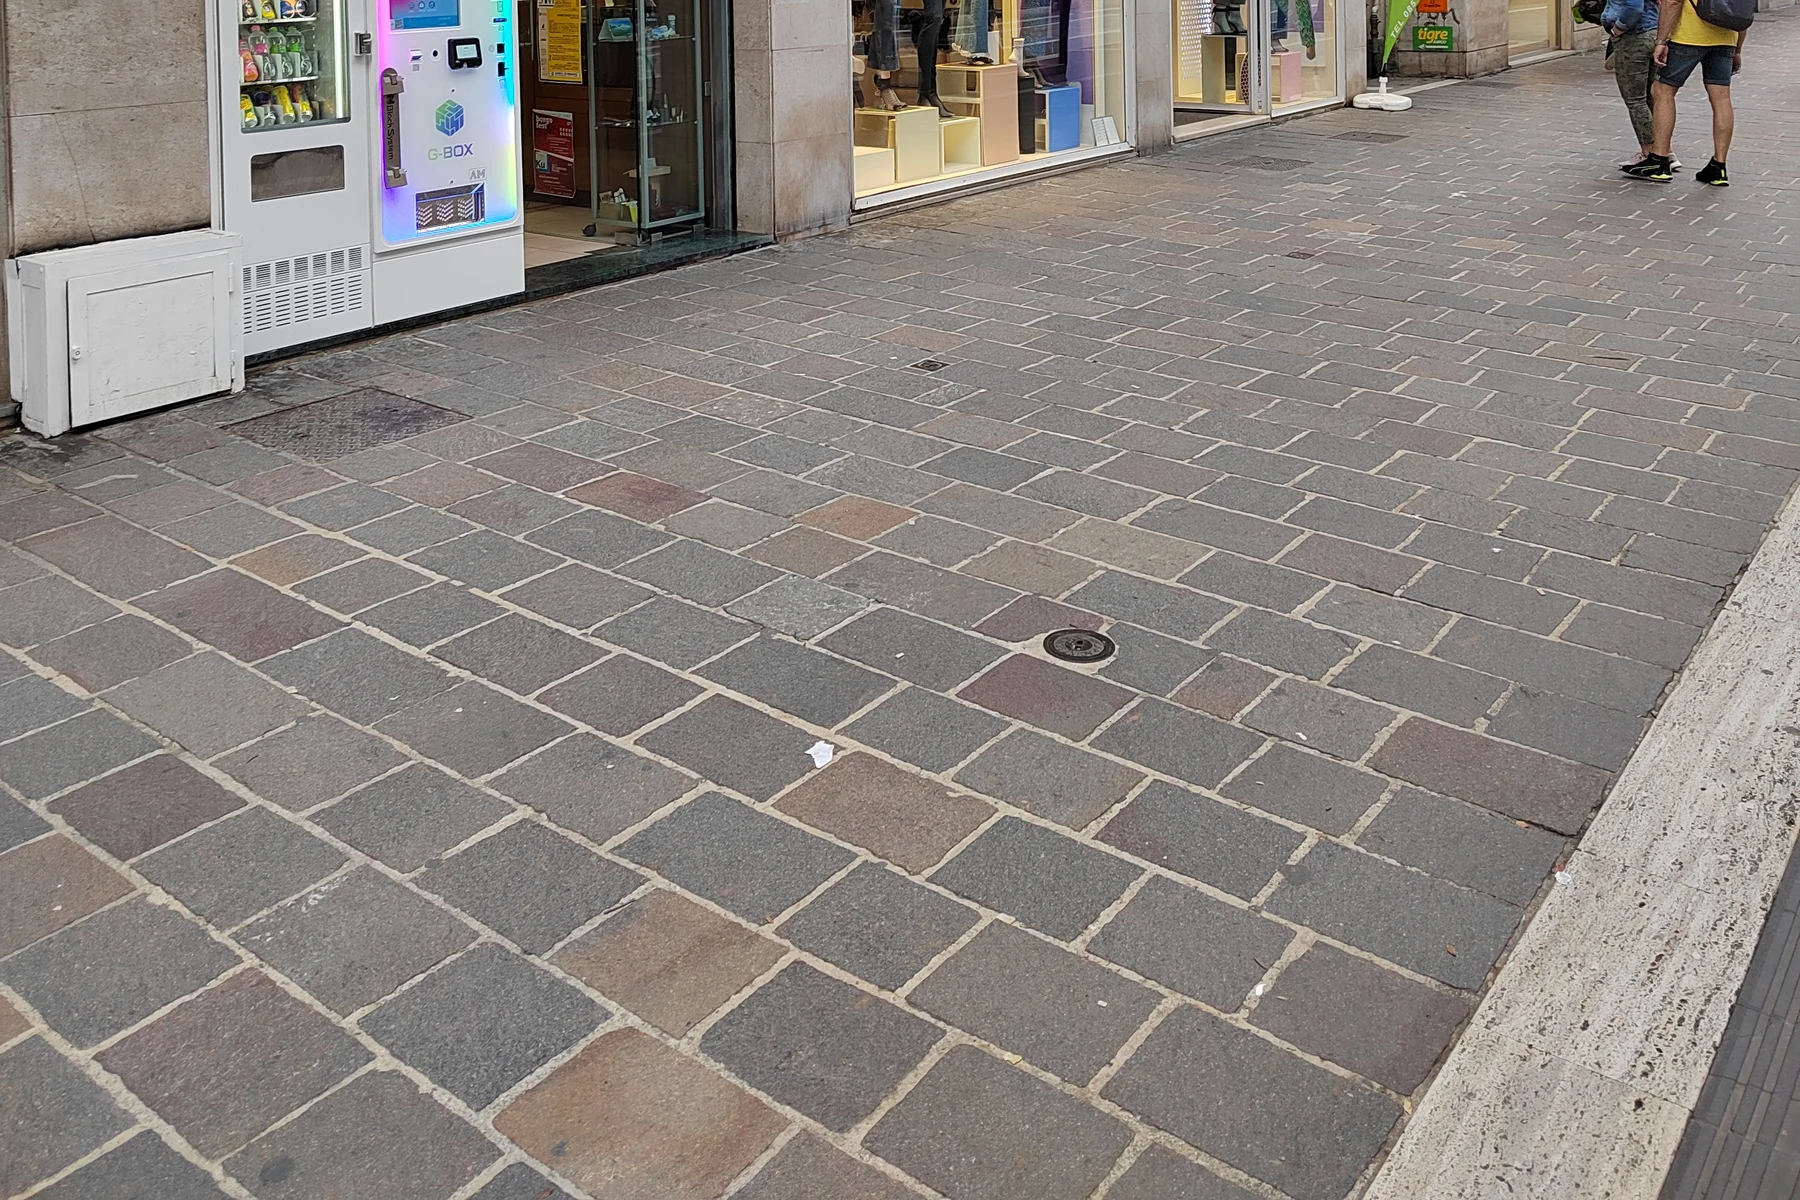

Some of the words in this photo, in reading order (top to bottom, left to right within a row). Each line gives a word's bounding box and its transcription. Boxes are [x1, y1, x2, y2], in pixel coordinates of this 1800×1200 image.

[1390, 20, 1405, 39] TEL
[1403, 0, 1416, 18] 085
[1417, 27, 1448, 44] tigre
[428, 143, 474, 161] G-BOX
